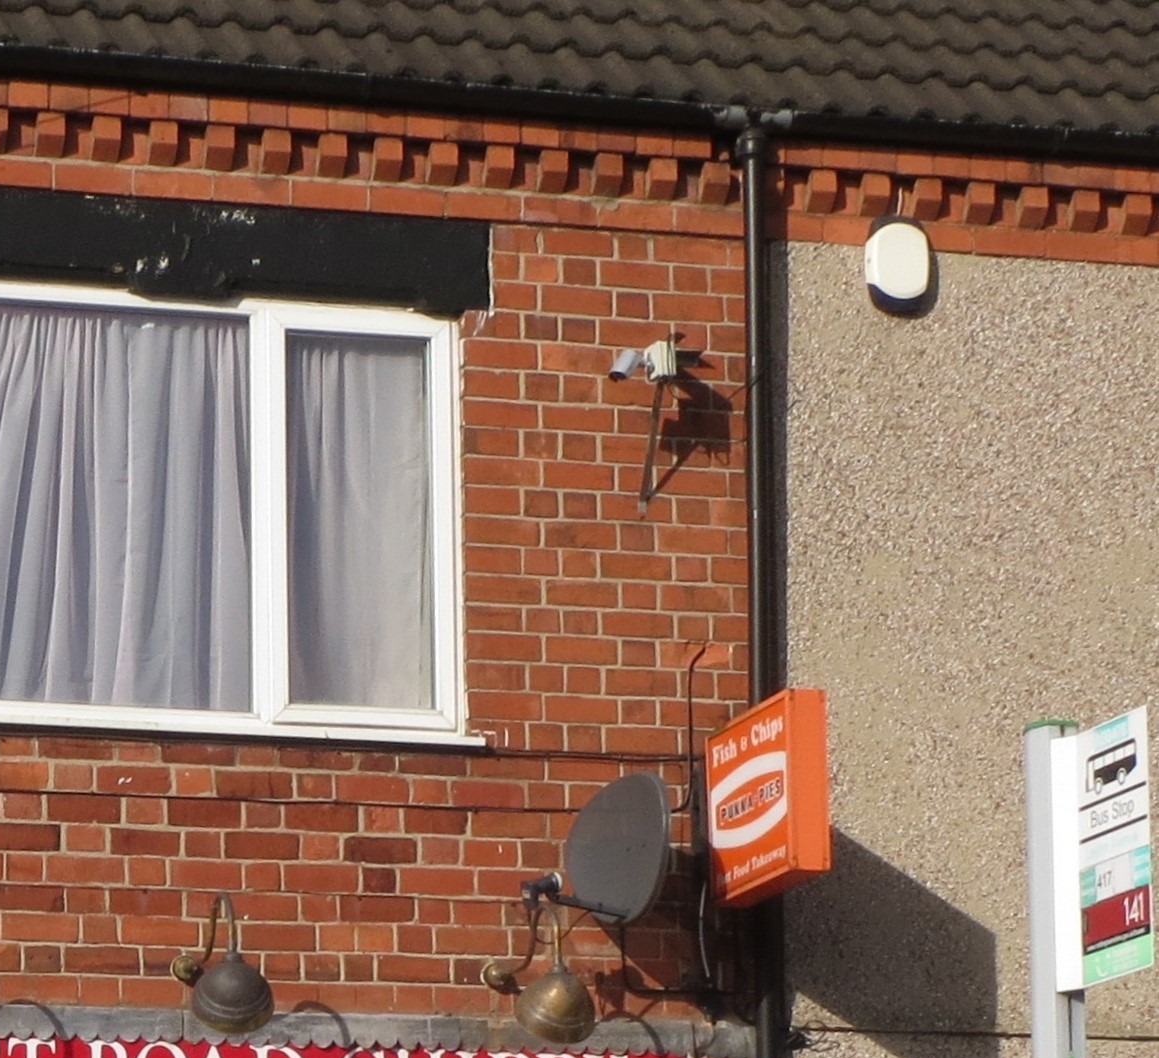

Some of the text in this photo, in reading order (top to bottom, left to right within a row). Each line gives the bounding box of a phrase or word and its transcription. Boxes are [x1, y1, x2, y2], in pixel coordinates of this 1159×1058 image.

[712, 737, 737, 768] Fish
[751, 715, 783, 747] Chips
[1090, 799, 1135, 829] Bus Stop
[733, 860, 750, 880] Food
[1097, 871, 1112, 889] 417
[1123, 891, 1144, 926] 141
